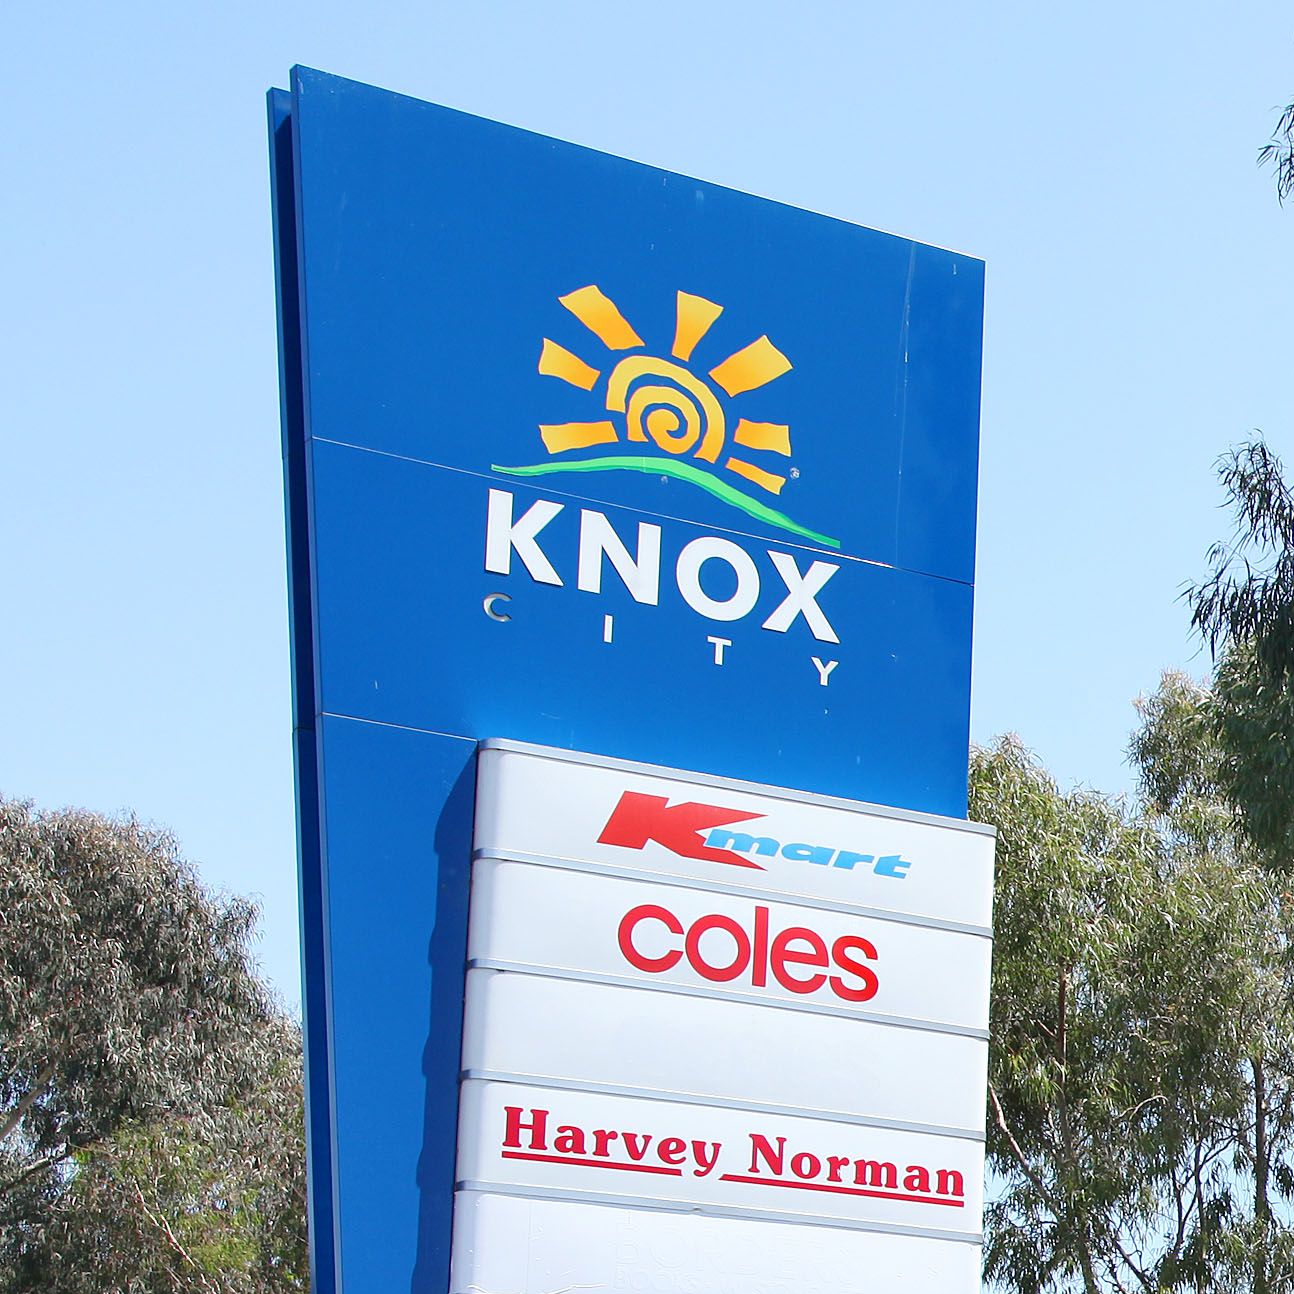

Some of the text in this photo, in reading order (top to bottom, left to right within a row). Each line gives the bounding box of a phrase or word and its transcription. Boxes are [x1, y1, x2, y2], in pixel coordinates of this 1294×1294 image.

[483, 488, 841, 645] KNOX
[482, 592, 839, 687] CITY
[596, 790, 912, 880] Kmart
[617, 904, 879, 1003] coles
[501, 1105, 965, 1198] Harvey Norman
